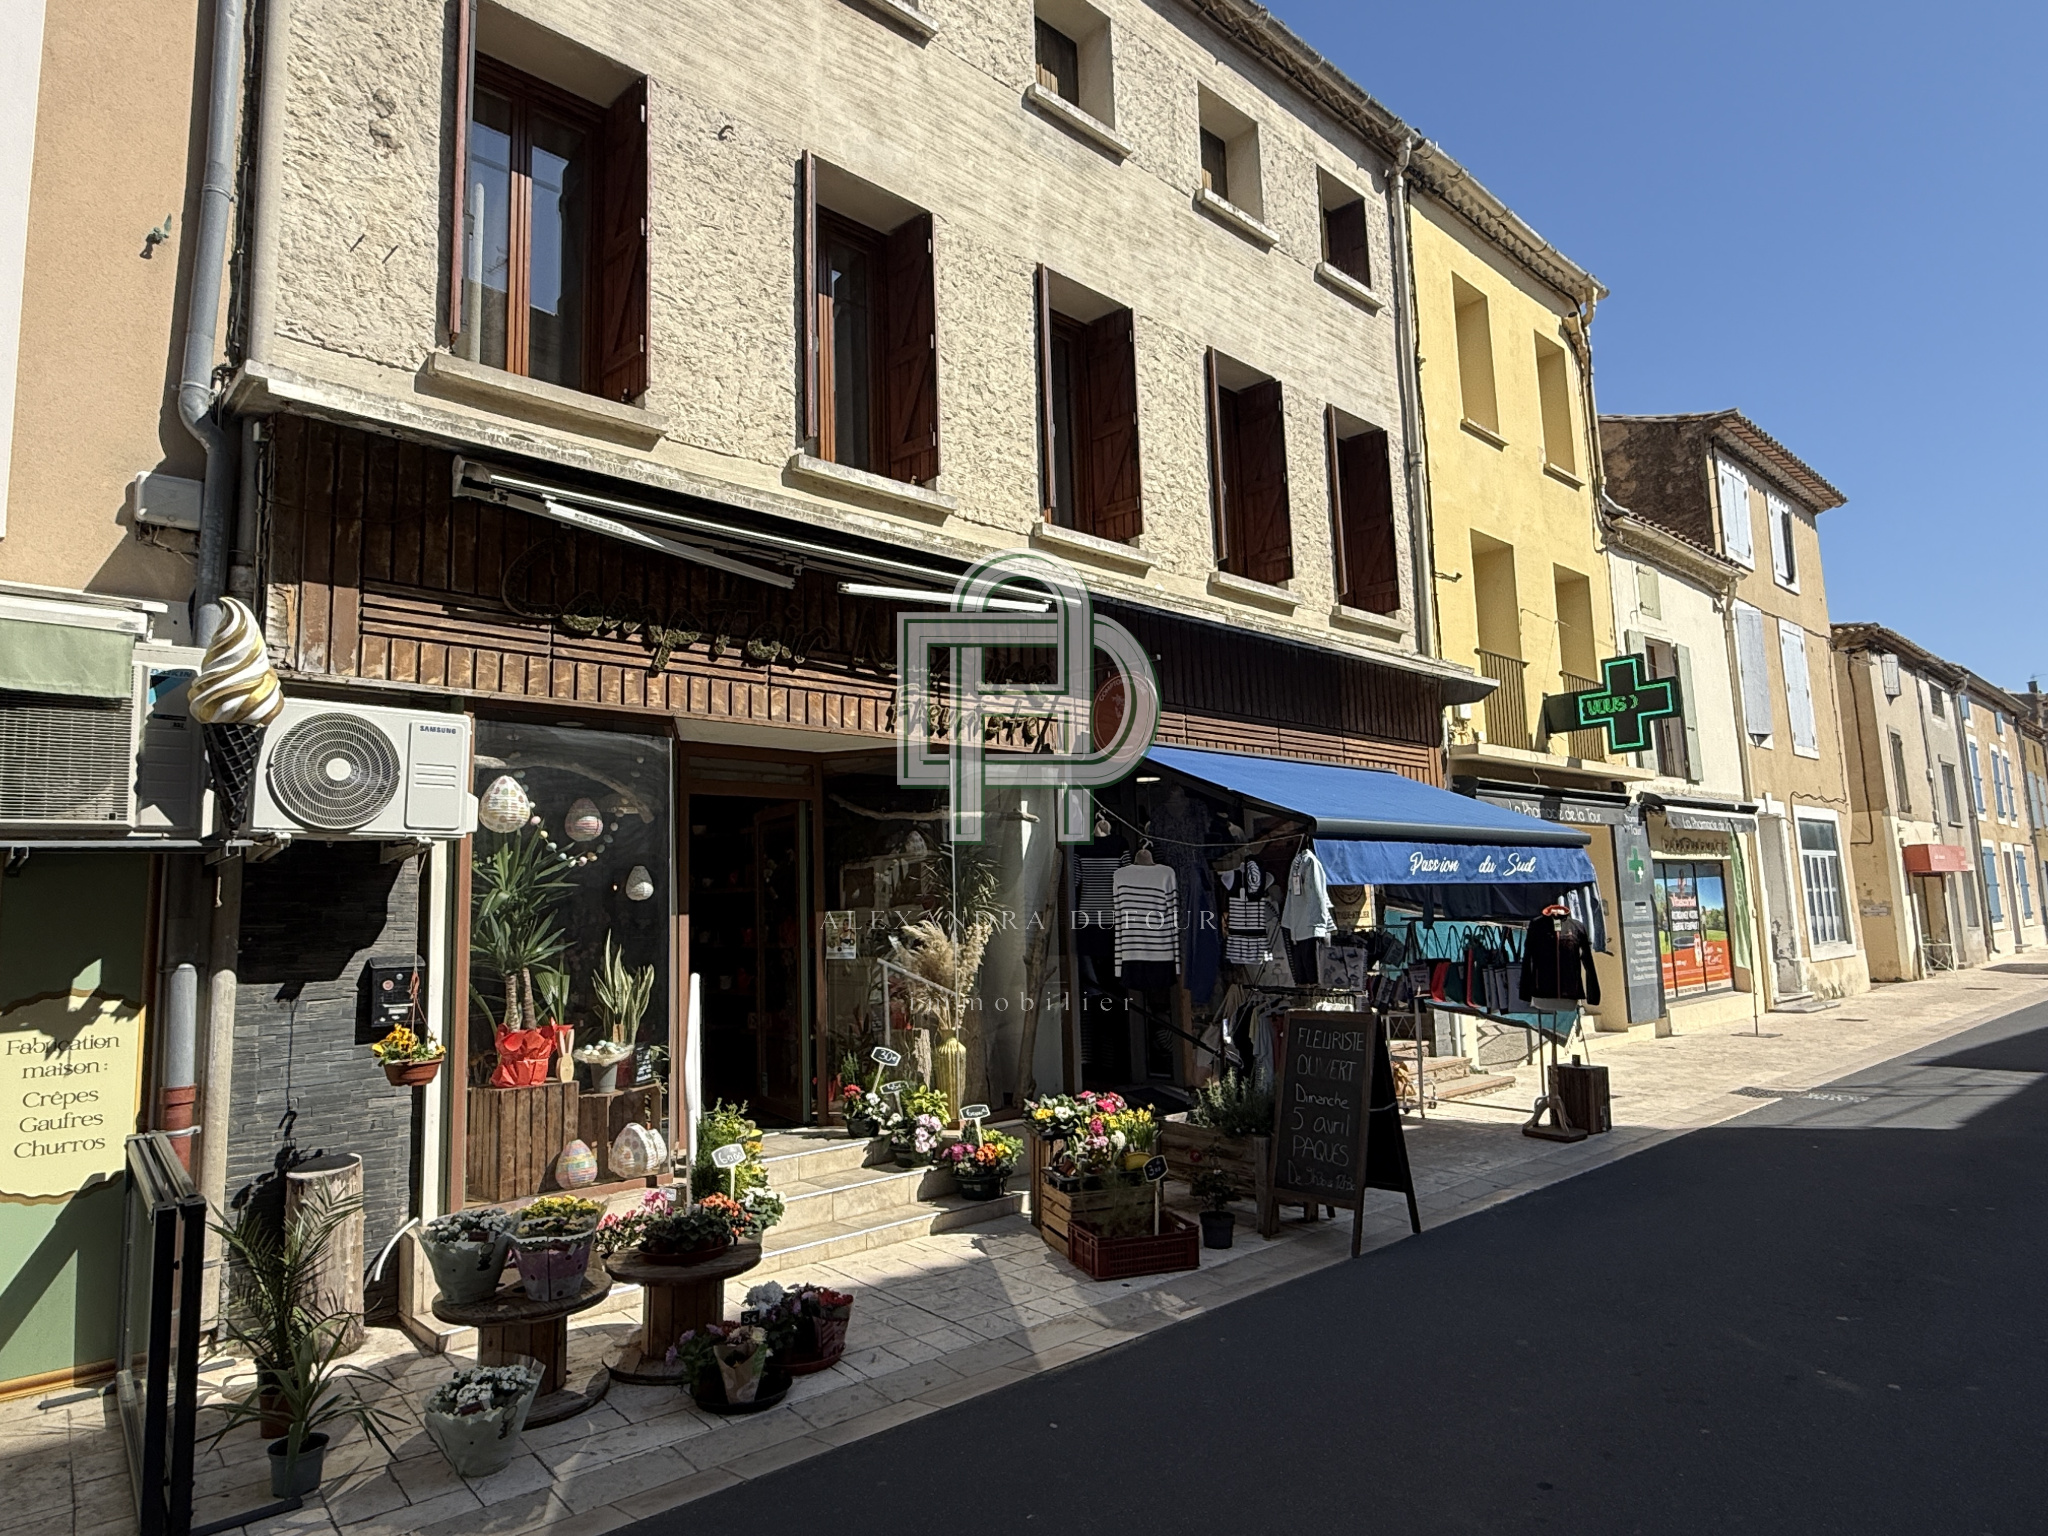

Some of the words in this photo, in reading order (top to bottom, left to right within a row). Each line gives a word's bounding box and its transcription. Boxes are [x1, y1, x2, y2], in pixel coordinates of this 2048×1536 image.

[419, 725, 457, 735] SAMSUNG
[1565, 806, 1577, 821] de
[1577, 807, 1585, 821] la
[1585, 807, 1602, 823] Tour
[1681, 815, 1691, 829] La
[1691, 816, 1717, 829] Pharmacie
[1409, 851, 1460, 876] Passion
[1478, 855, 1497, 874] du
[1503, 852, 1537, 876] Sud
[6, 1034, 120, 1056] Fabrication
[1297, 1027, 1364, 1052] FLEURISTE
[1297, 1054, 1358, 1082] OUVERT
[22, 1090, 99, 1110] Crêpes
[1295, 1083, 1350, 1110] Dimanche
[19, 1112, 104, 1133] Gaufres
[1290, 1107, 1305, 1131] 5
[1313, 1114, 1350, 1137] avril
[14, 1137, 106, 1158] Churros
[1292, 1134, 1350, 1167] PAQUES
[743, 1313, 757, 1324] 5€
